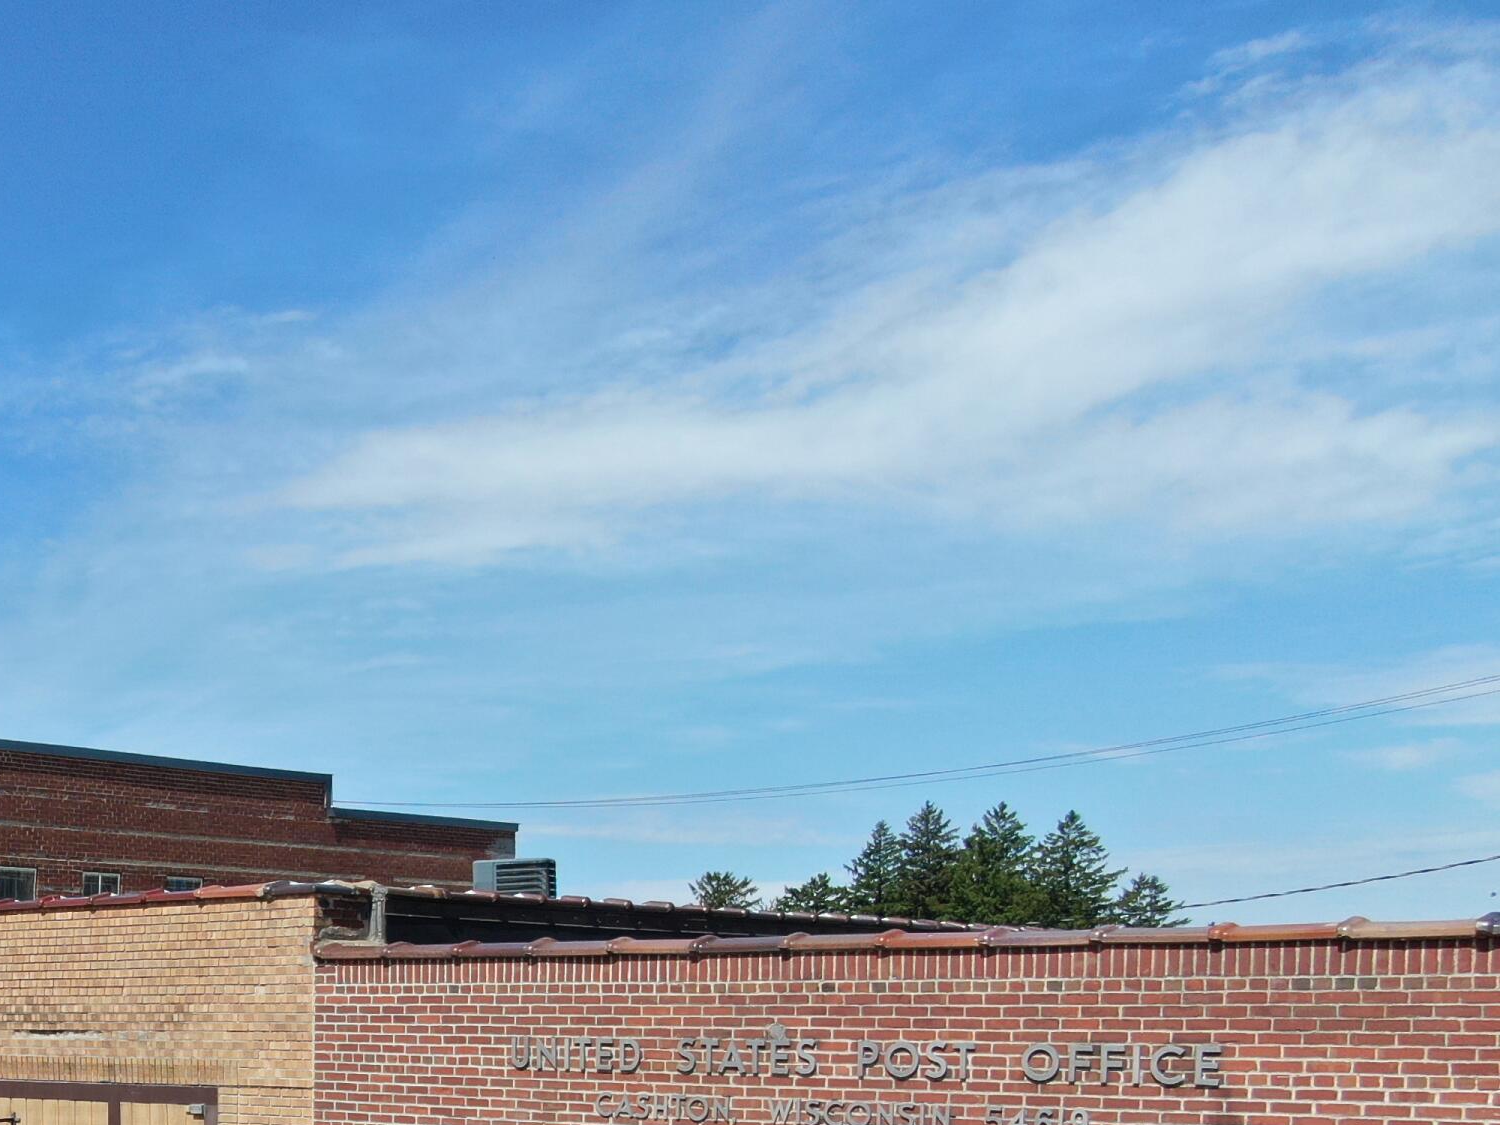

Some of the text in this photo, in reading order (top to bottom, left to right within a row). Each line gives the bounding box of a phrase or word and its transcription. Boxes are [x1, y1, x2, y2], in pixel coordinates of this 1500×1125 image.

[510, 1035, 1222, 1088] UNITED STATES POST OFFICE
[595, 1091, 737, 1125] CASHTON,
